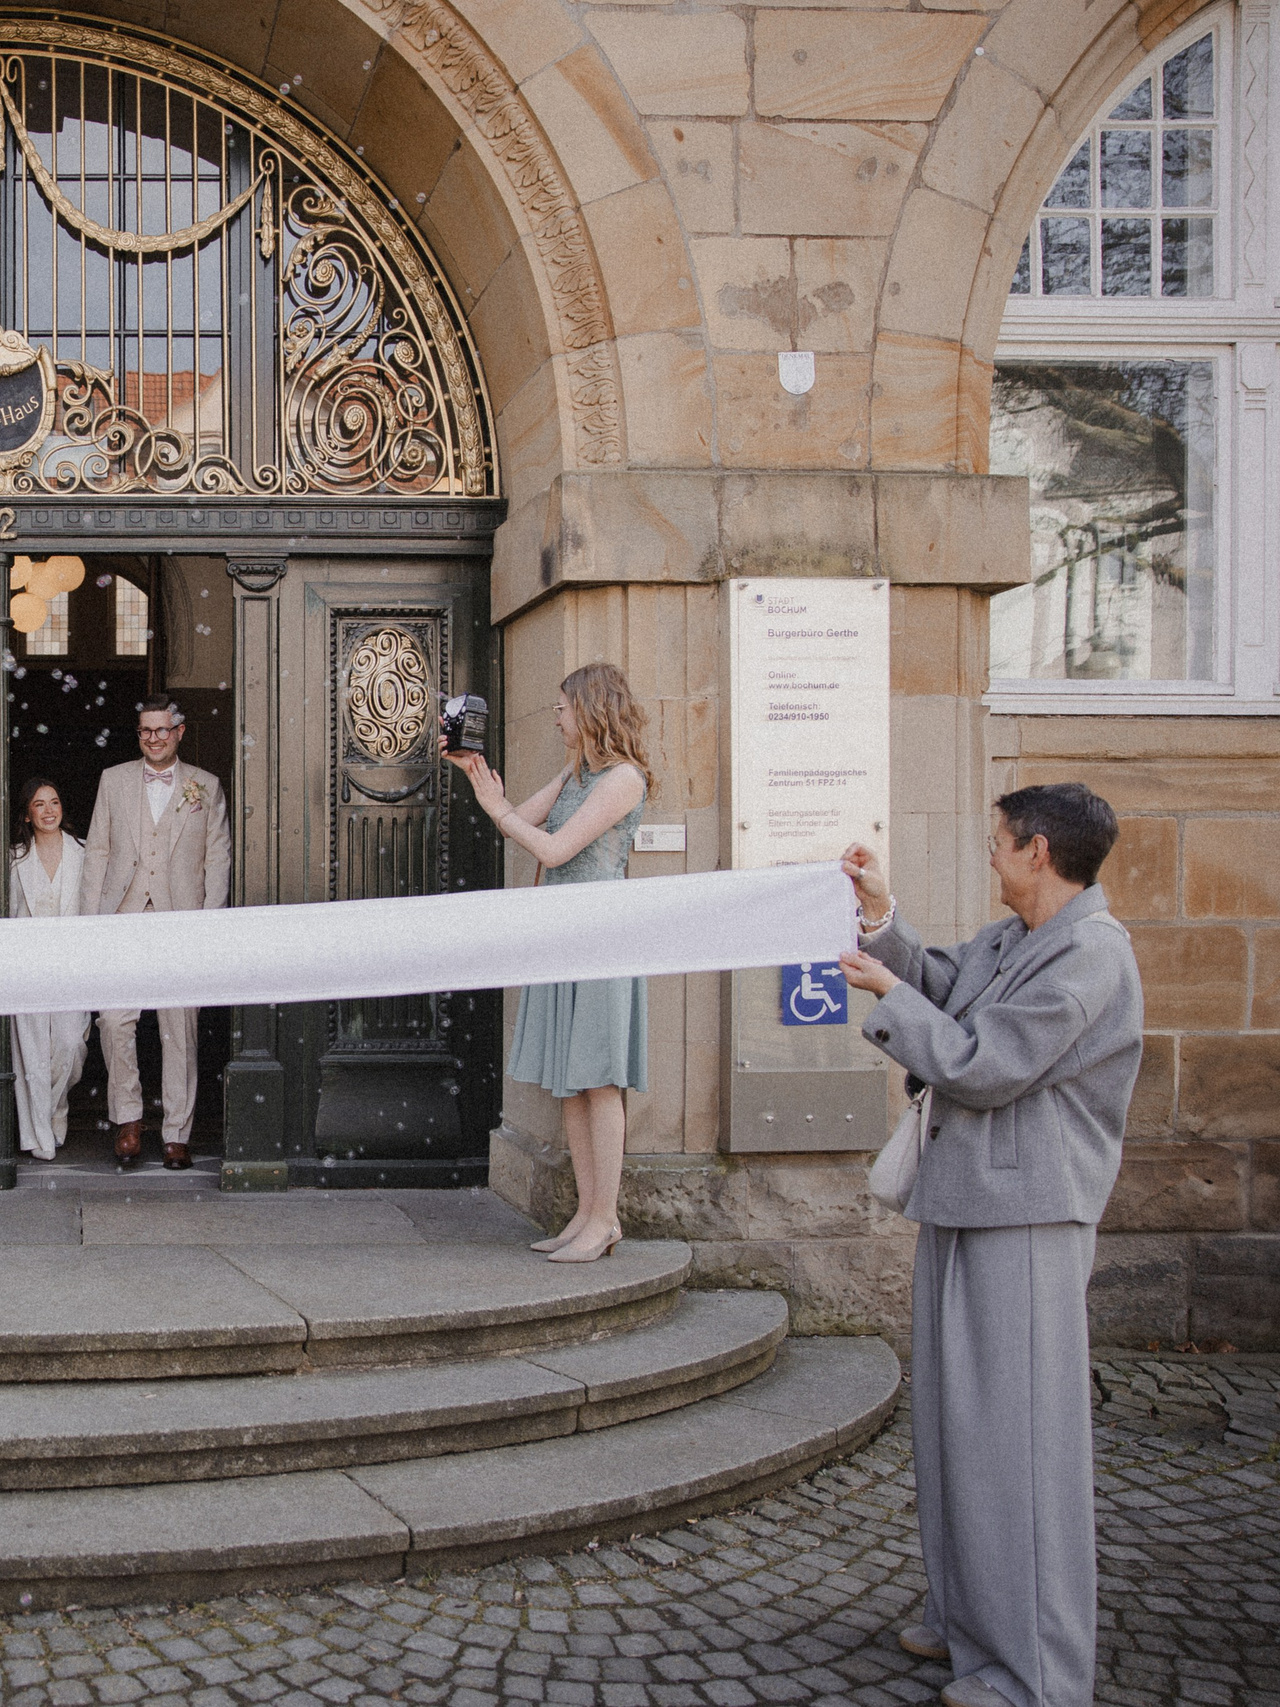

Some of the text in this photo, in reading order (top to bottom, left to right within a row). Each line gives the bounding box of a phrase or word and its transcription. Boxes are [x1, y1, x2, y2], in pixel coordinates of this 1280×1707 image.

[767, 605, 807, 614] BOCHUM
[767, 629, 859, 639] Bürgerbüro Gerthe
[768, 681, 840, 690] www.bochum.de
[768, 712, 830, 721] 0234/910-1950
[768, 769, 868, 778] Familienpädagogisches
[768, 779, 847, 787] Zentrum 51 FPZ 14
[795, 819, 822, 827] Kinder
[823, 819, 839, 827] und
